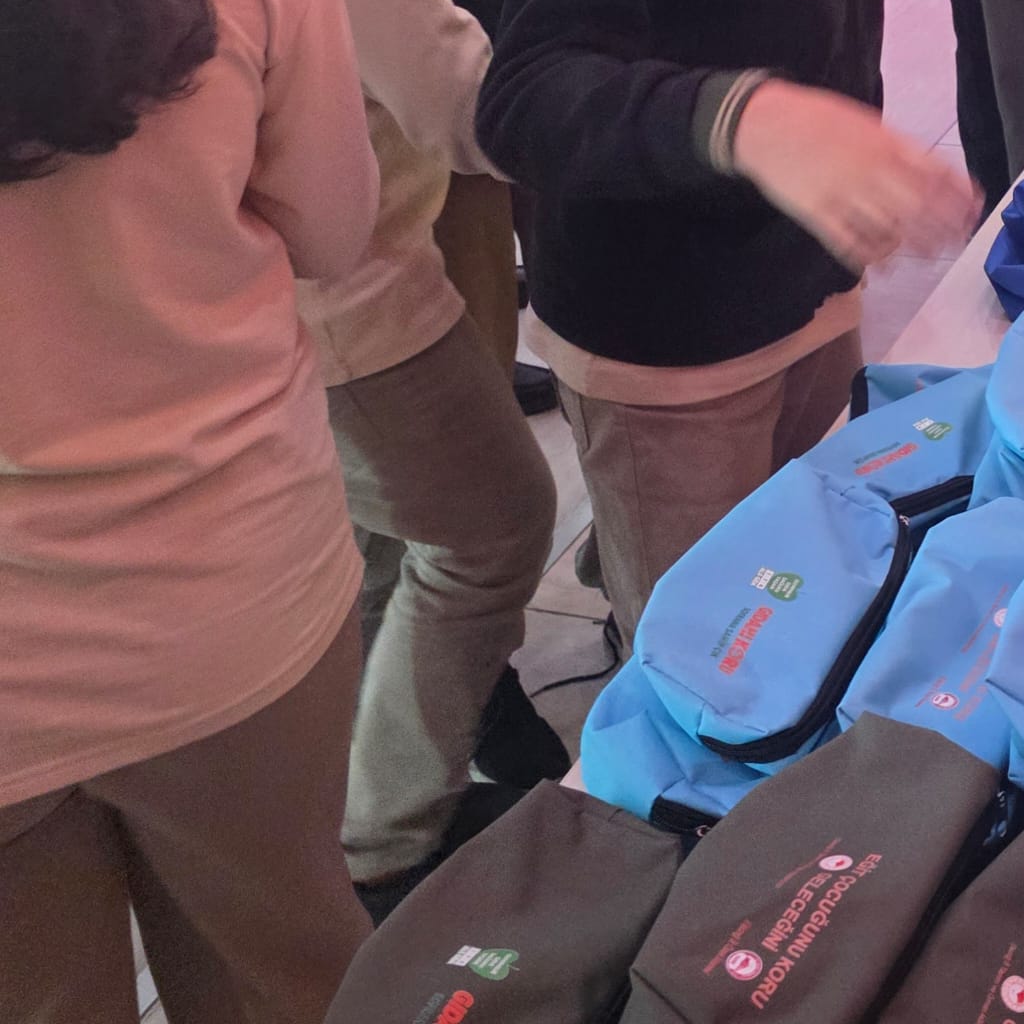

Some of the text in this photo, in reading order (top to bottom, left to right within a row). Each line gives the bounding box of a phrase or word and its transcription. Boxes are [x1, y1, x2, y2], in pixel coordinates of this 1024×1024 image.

[851, 853, 882, 879] EĞİT
[761, 872, 831, 953] GELECEĞİNİ
[787, 875, 856, 958] ÇOCUĞUNU
[749, 956, 795, 1010] KORU
